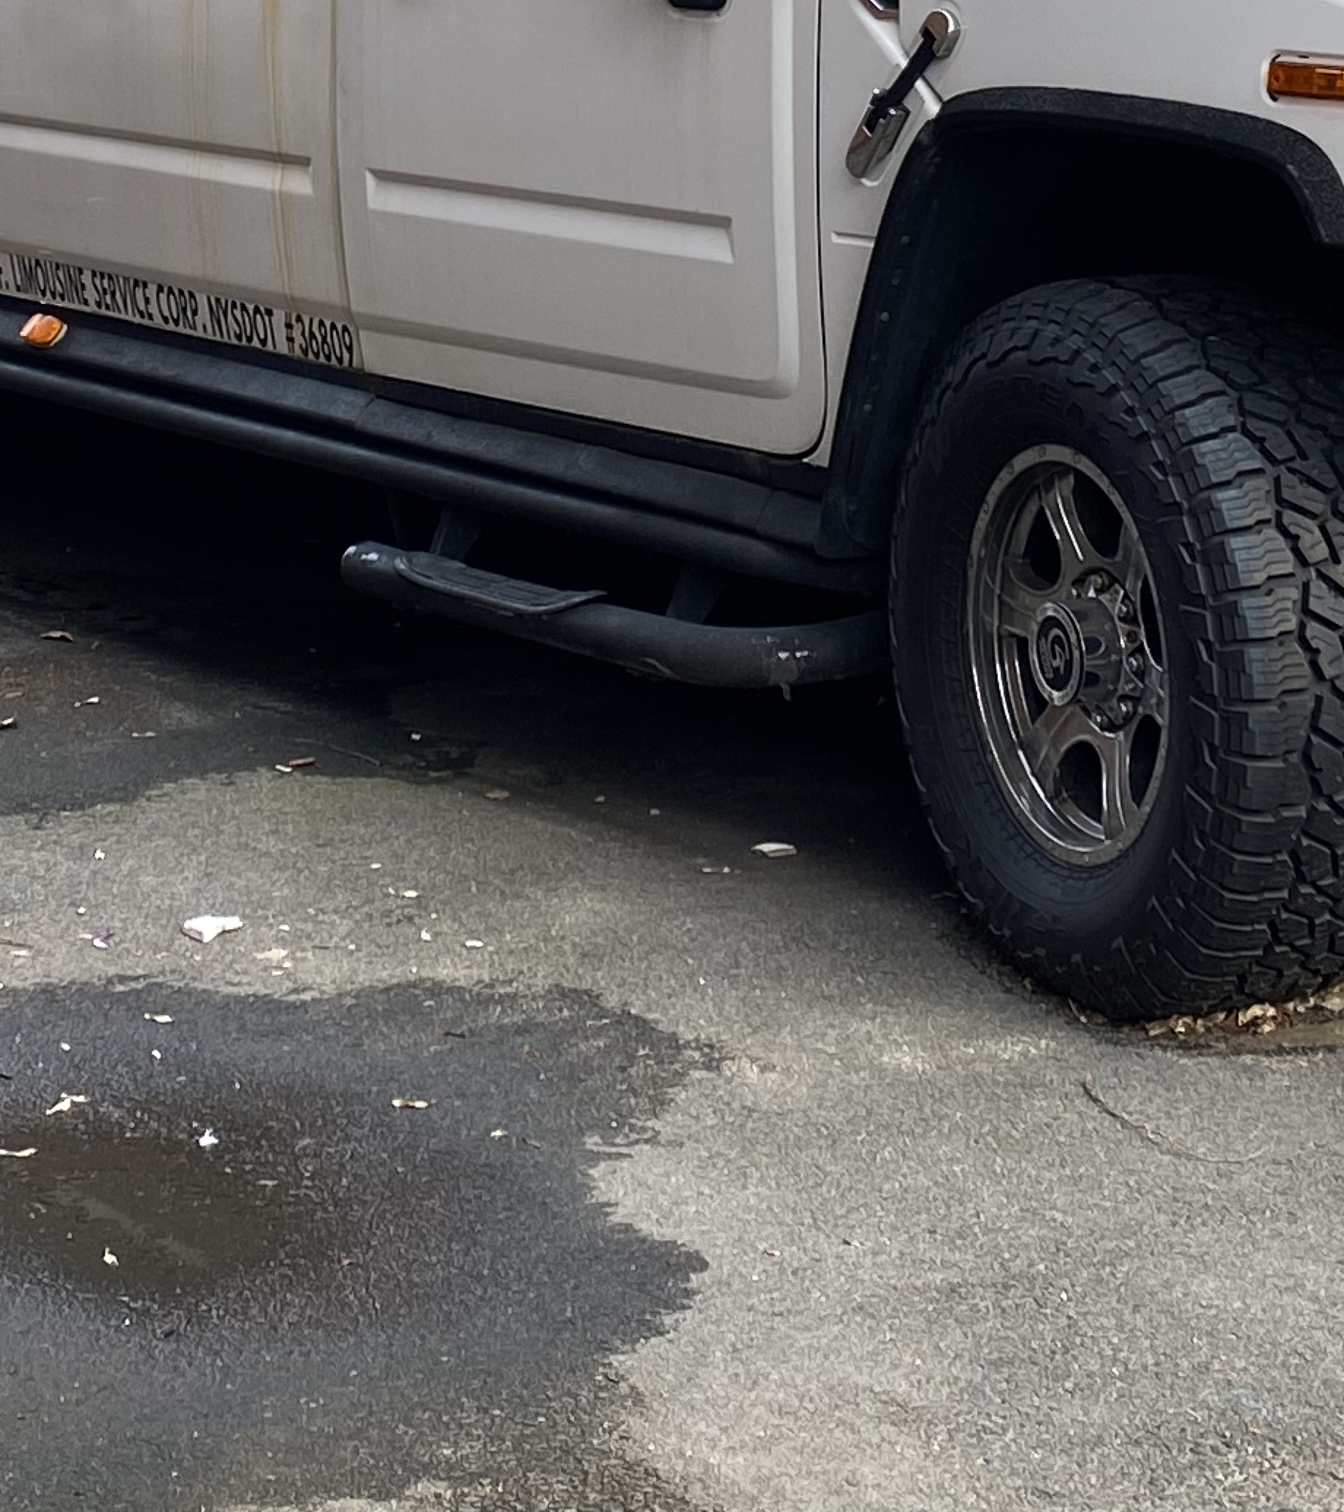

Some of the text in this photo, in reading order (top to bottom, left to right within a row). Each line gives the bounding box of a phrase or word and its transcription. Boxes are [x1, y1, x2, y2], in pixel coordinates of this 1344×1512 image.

[9, 253, 89, 306] LIMOUSINE
[91, 269, 154, 322] SERVICE
[206, 295, 277, 350] NYSDOT
[284, 311, 354, 368] #36809
